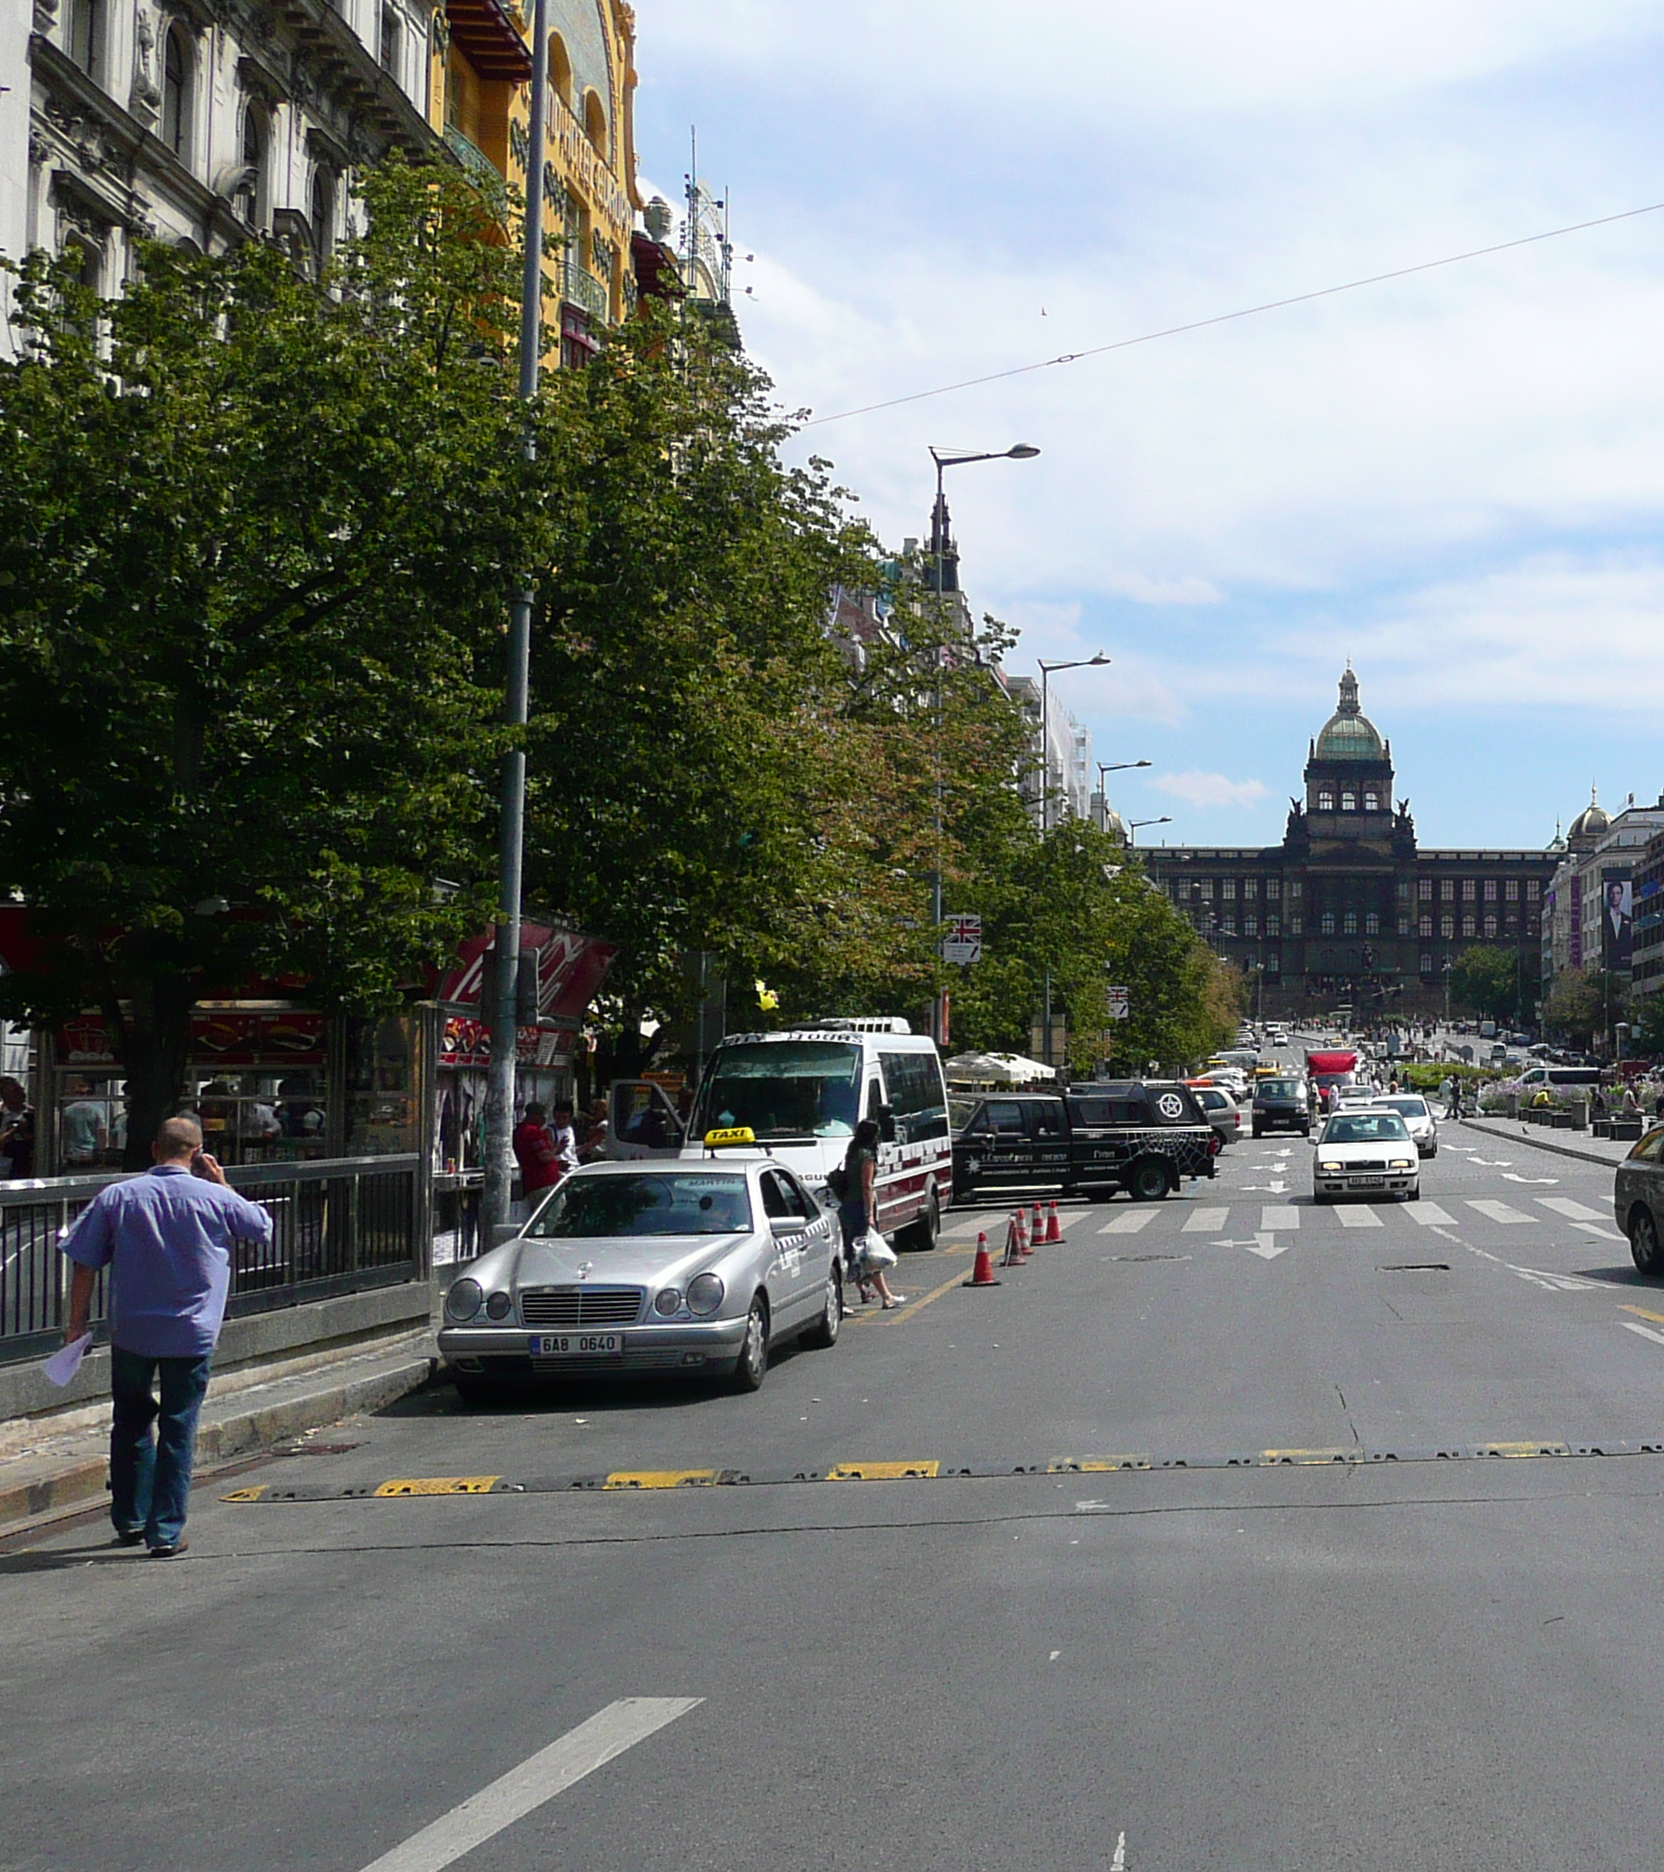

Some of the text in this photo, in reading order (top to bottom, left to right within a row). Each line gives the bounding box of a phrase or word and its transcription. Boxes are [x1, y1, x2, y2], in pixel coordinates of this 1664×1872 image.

[711, 1129, 747, 1140] TAXI
[543, 1336, 615, 1352] 6A8 0640
